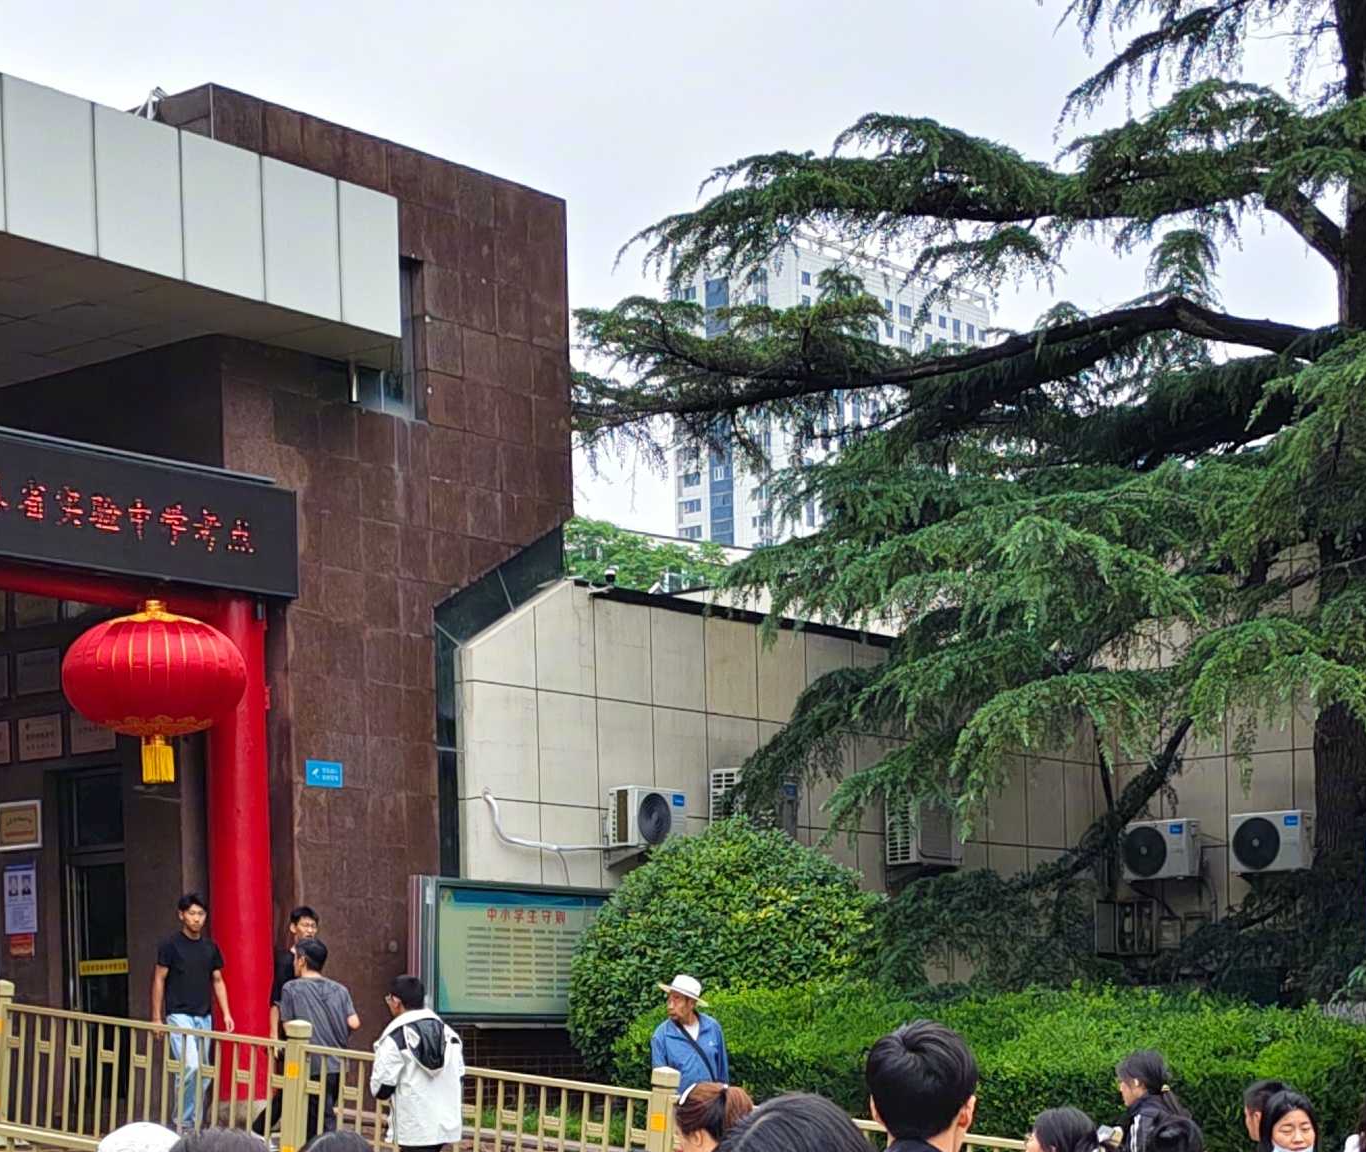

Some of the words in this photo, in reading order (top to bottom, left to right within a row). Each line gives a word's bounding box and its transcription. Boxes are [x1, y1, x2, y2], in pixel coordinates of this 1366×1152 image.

[486, 907, 566, 926] 中小学生守则
